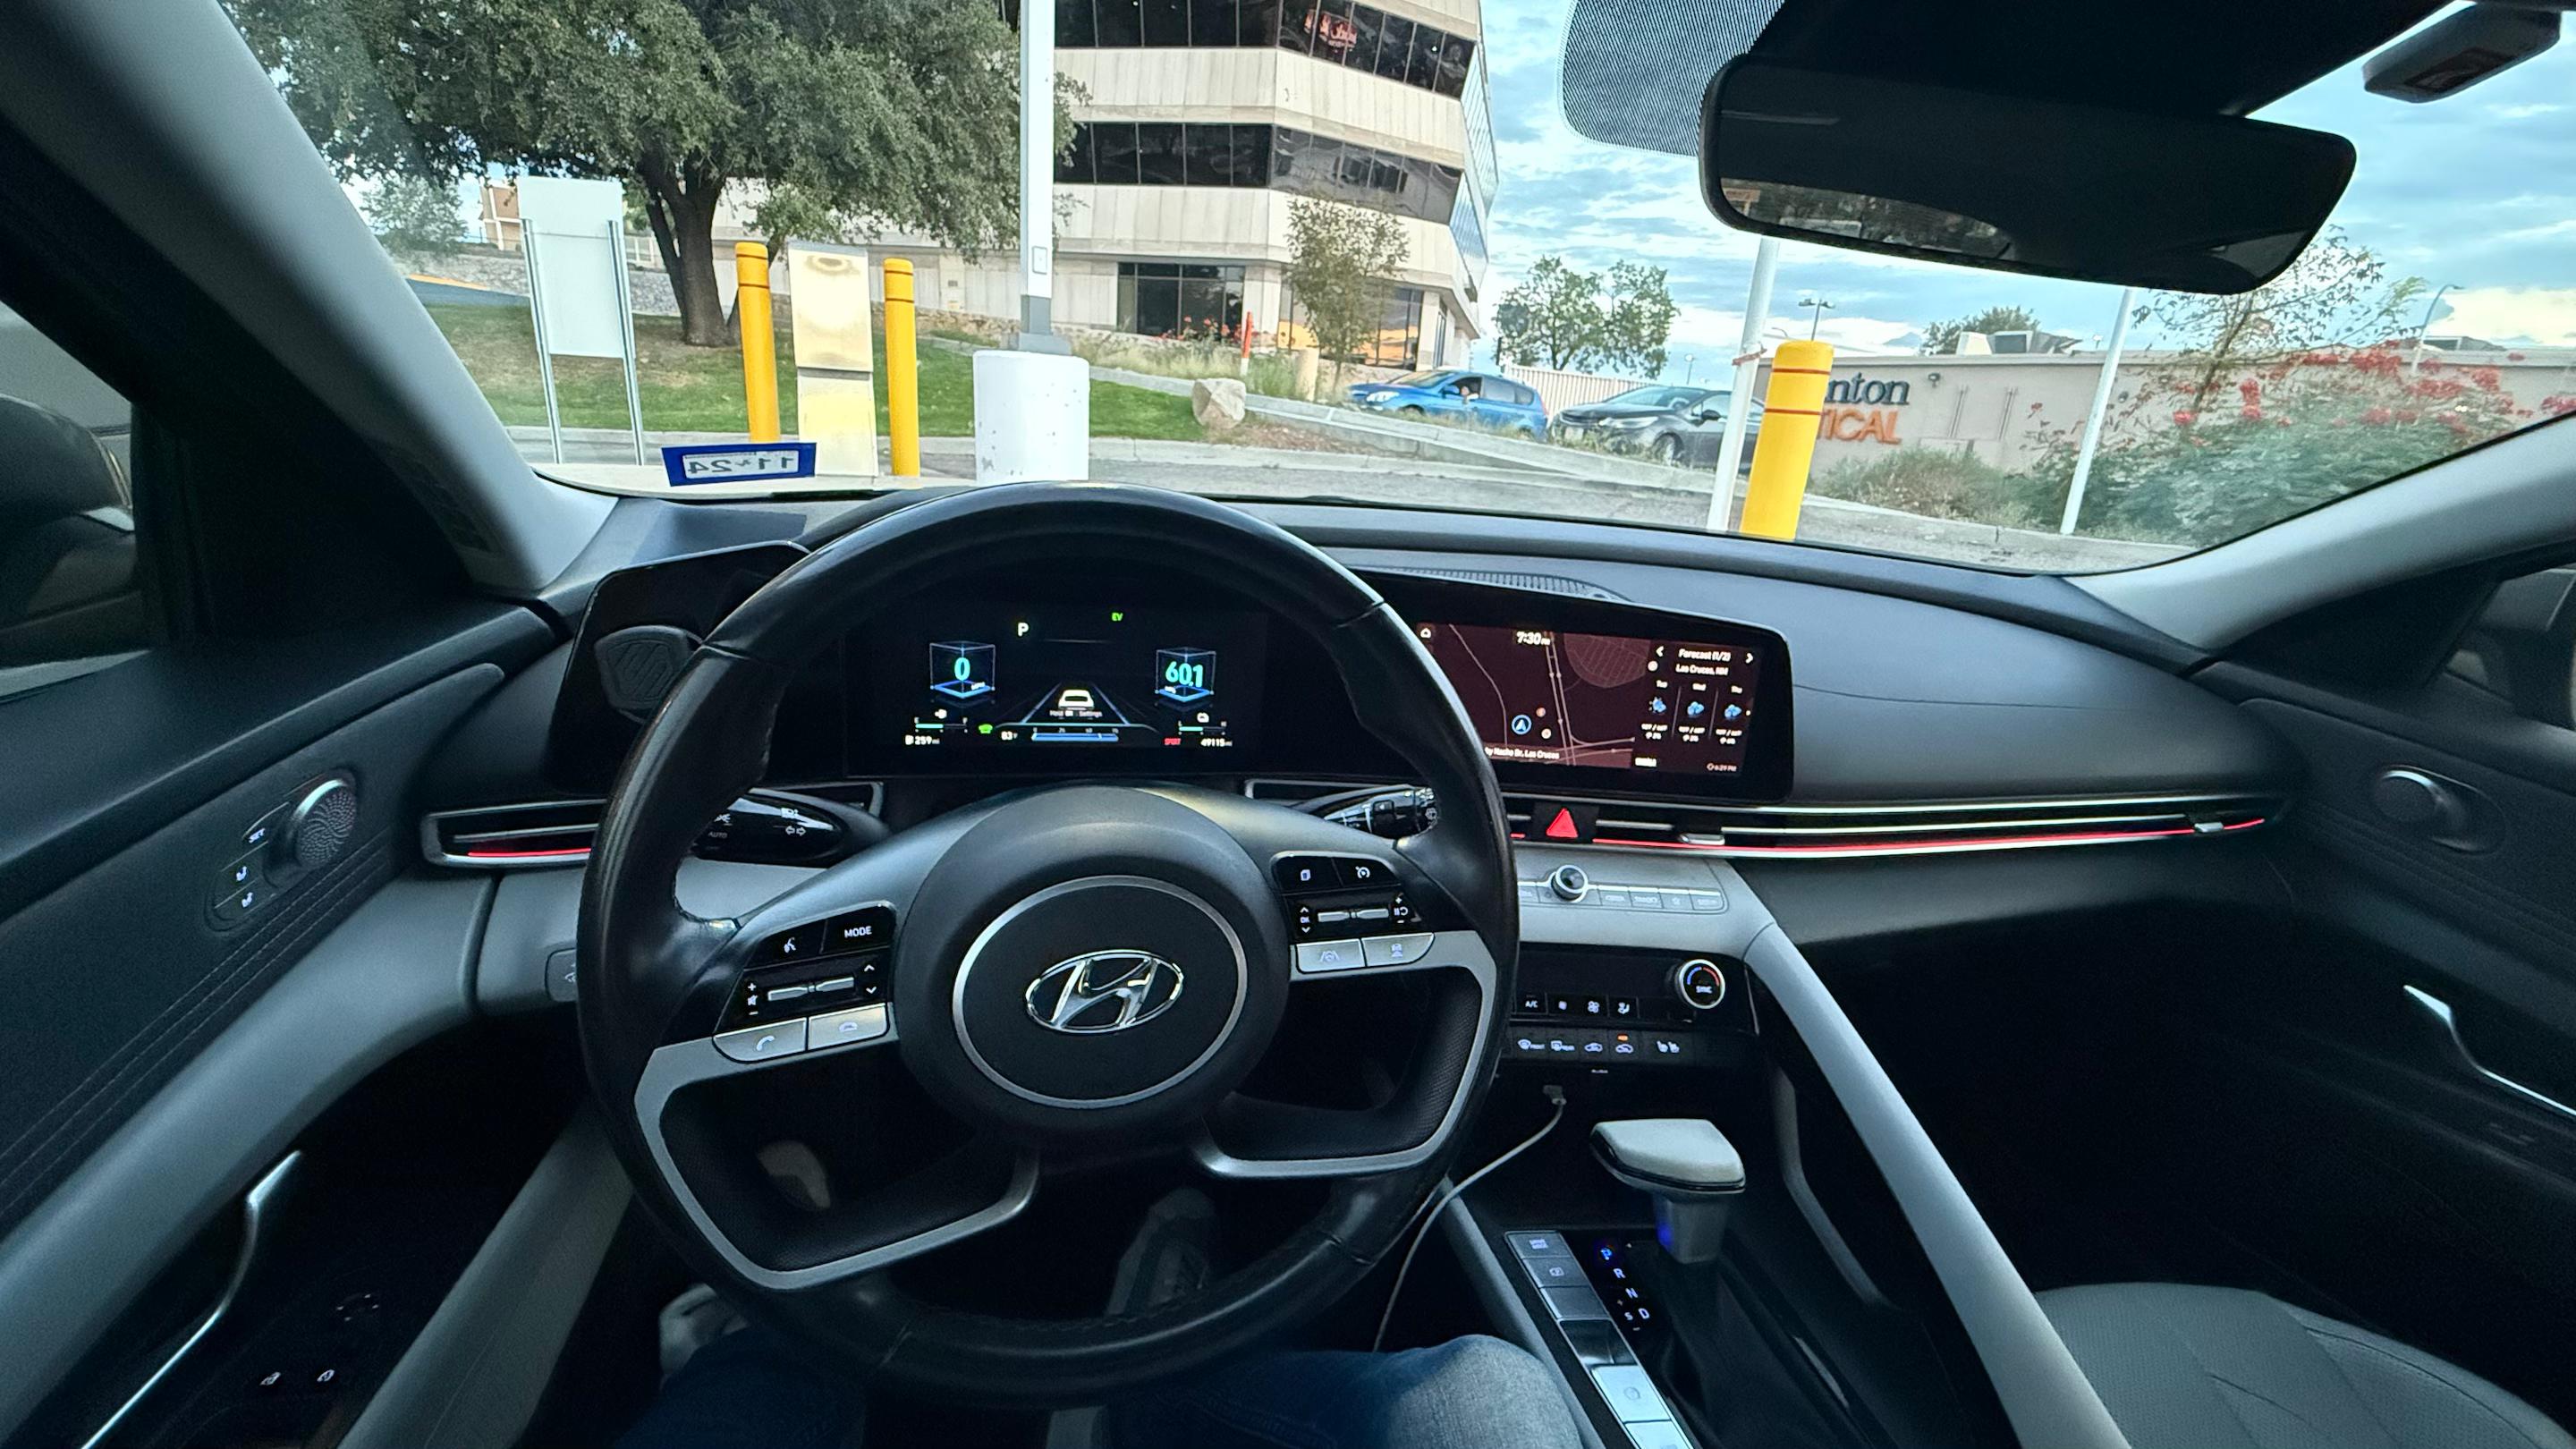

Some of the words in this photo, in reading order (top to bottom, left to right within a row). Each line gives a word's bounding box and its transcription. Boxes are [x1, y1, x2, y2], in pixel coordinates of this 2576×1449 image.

[1111, 612, 1123, 622] EV
[1017, 622, 1030, 637] P
[1516, 631, 1542, 645] 7:30
[1678, 648, 1712, 660] Forecast
[953, 657, 970, 681] 0
[1165, 661, 1204, 688] 60.1
[708, 831, 728, 839] AUTO
[843, 926, 872, 938] MODE
[1525, 1000, 1538, 1008] A/C
[1613, 1268, 1626, 1278] R
[1625, 1287, 1639, 1299] N
[1624, 1311, 1633, 1320] S
[1638, 1308, 1650, 1319] D
